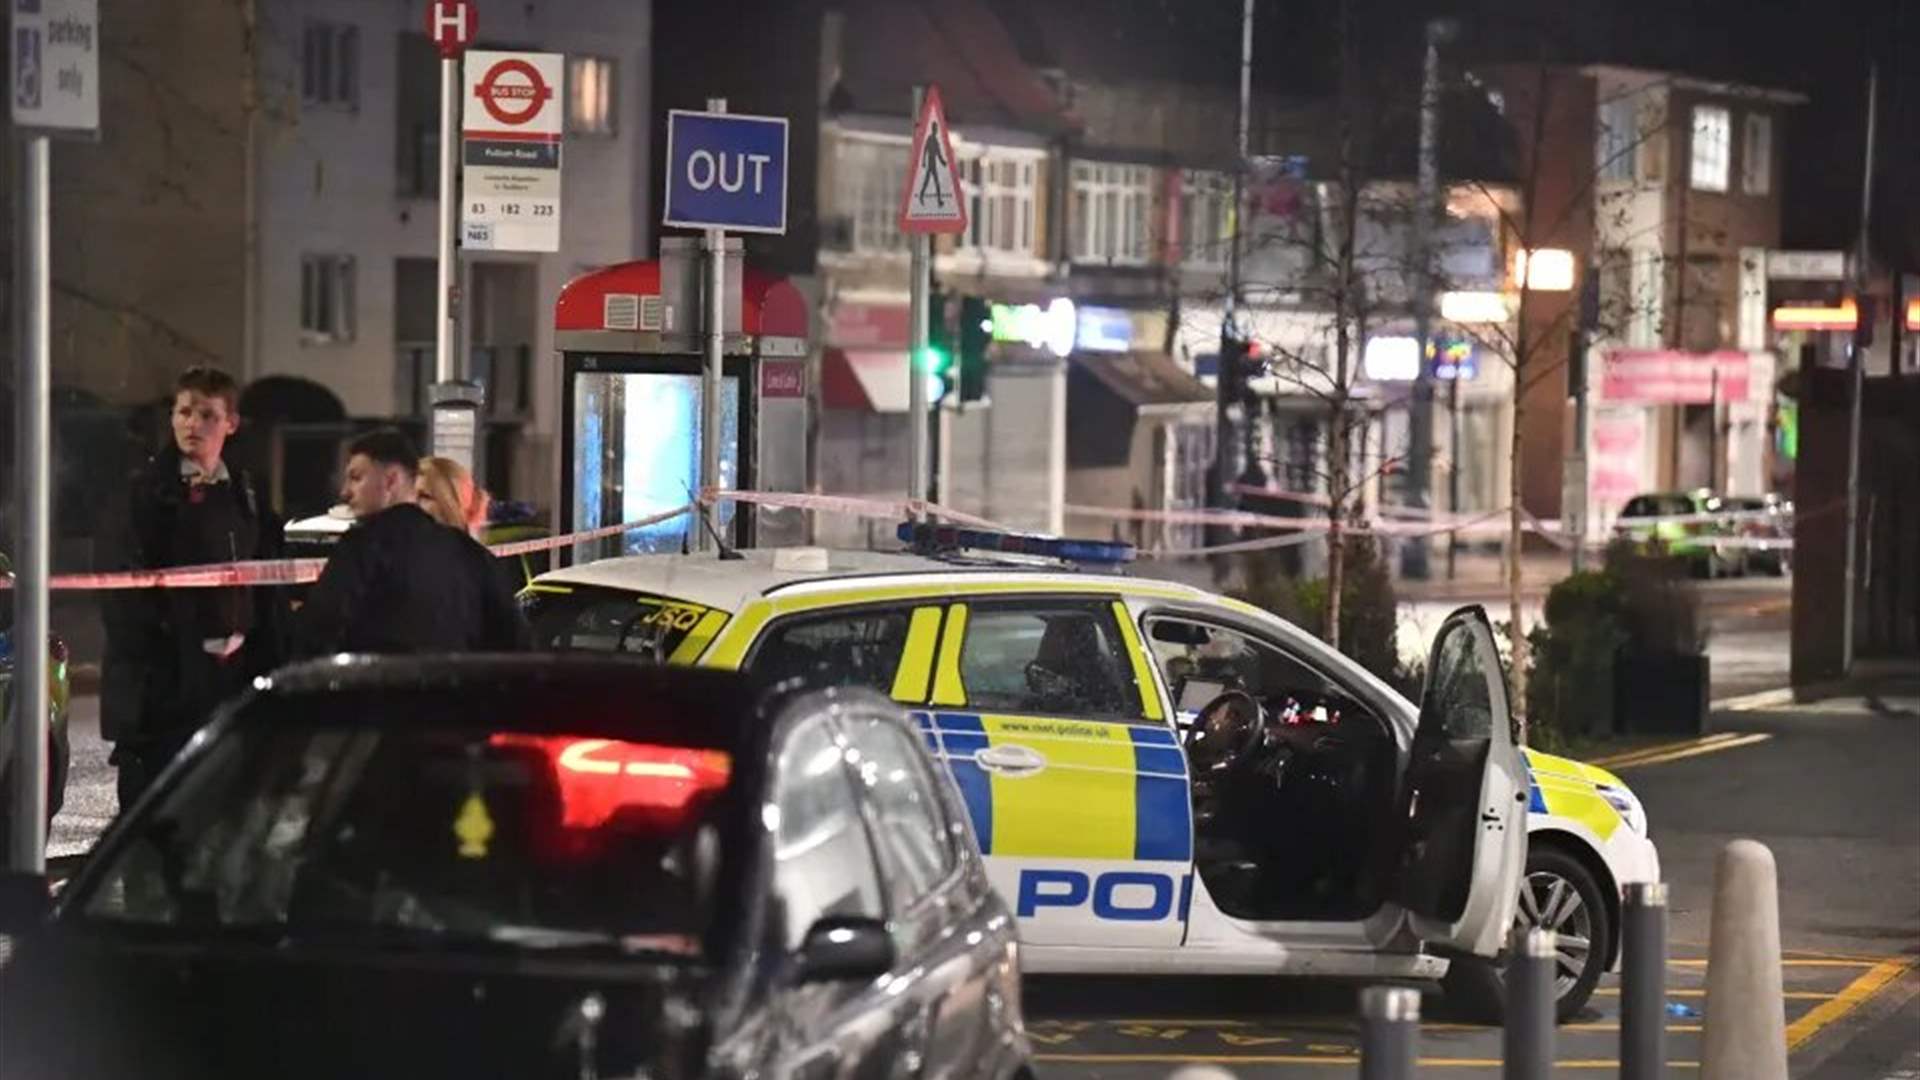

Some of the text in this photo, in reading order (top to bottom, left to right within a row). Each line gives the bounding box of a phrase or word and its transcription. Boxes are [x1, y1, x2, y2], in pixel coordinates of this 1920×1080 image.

[48, 11, 92, 52] parking
[434, 2, 466, 41] H
[58, 60, 83, 100] only
[490, 86, 536, 98] BUS STOP
[687, 149, 771, 194] OUT
[501, 203, 521, 215] 182
[533, 204, 555, 217] 223
